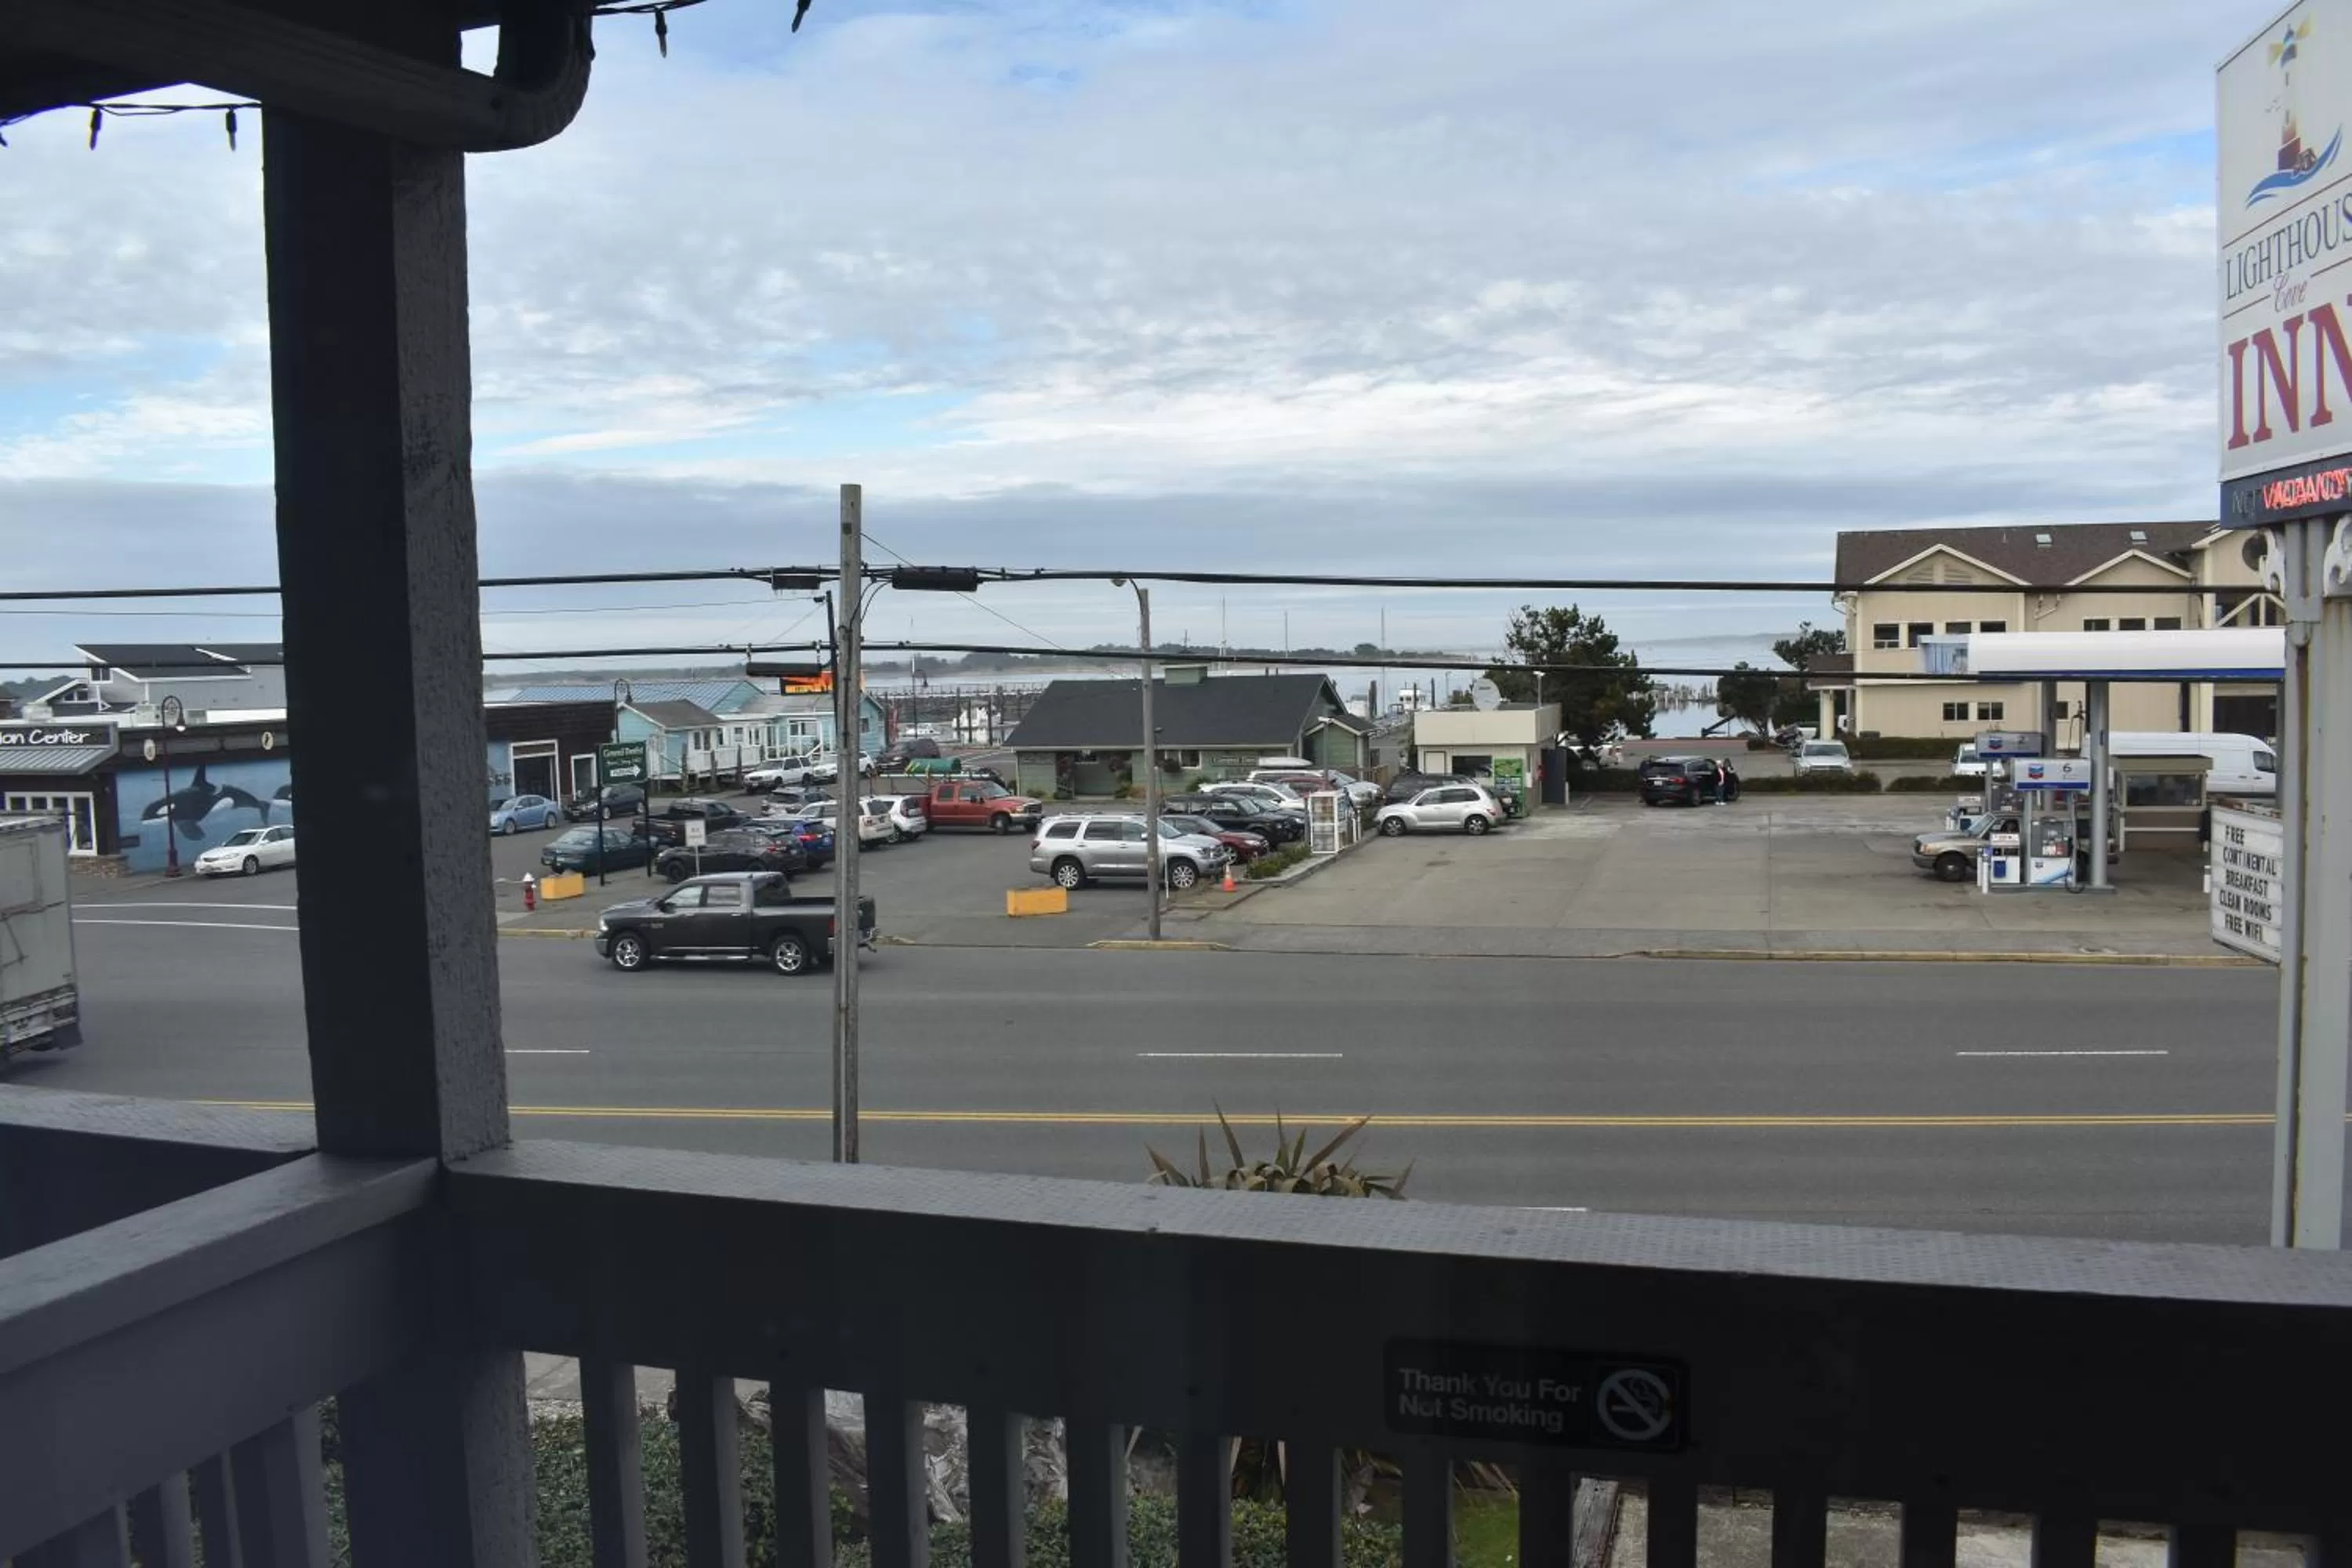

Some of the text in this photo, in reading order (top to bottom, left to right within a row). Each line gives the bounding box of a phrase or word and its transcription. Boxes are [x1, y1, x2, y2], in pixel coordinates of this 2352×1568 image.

[2274, 273, 2307, 312] Cove
[2228, 293, 2352, 451] INN
[29, 729, 91, 744] Center
[2063, 764, 2072, 772] 6
[2225, 826, 2245, 846] FREE
[2223, 846, 2277, 876] CONTINENTAL
[2226, 869, 2268, 898] BREAKFAST
[2220, 890, 2271, 920] CLEAN ROOMS
[2225, 913, 2263, 942] FREE WIFI
[1398, 1367, 1581, 1403] Thank You For
[1398, 1394, 1564, 1433] Not Smoking
